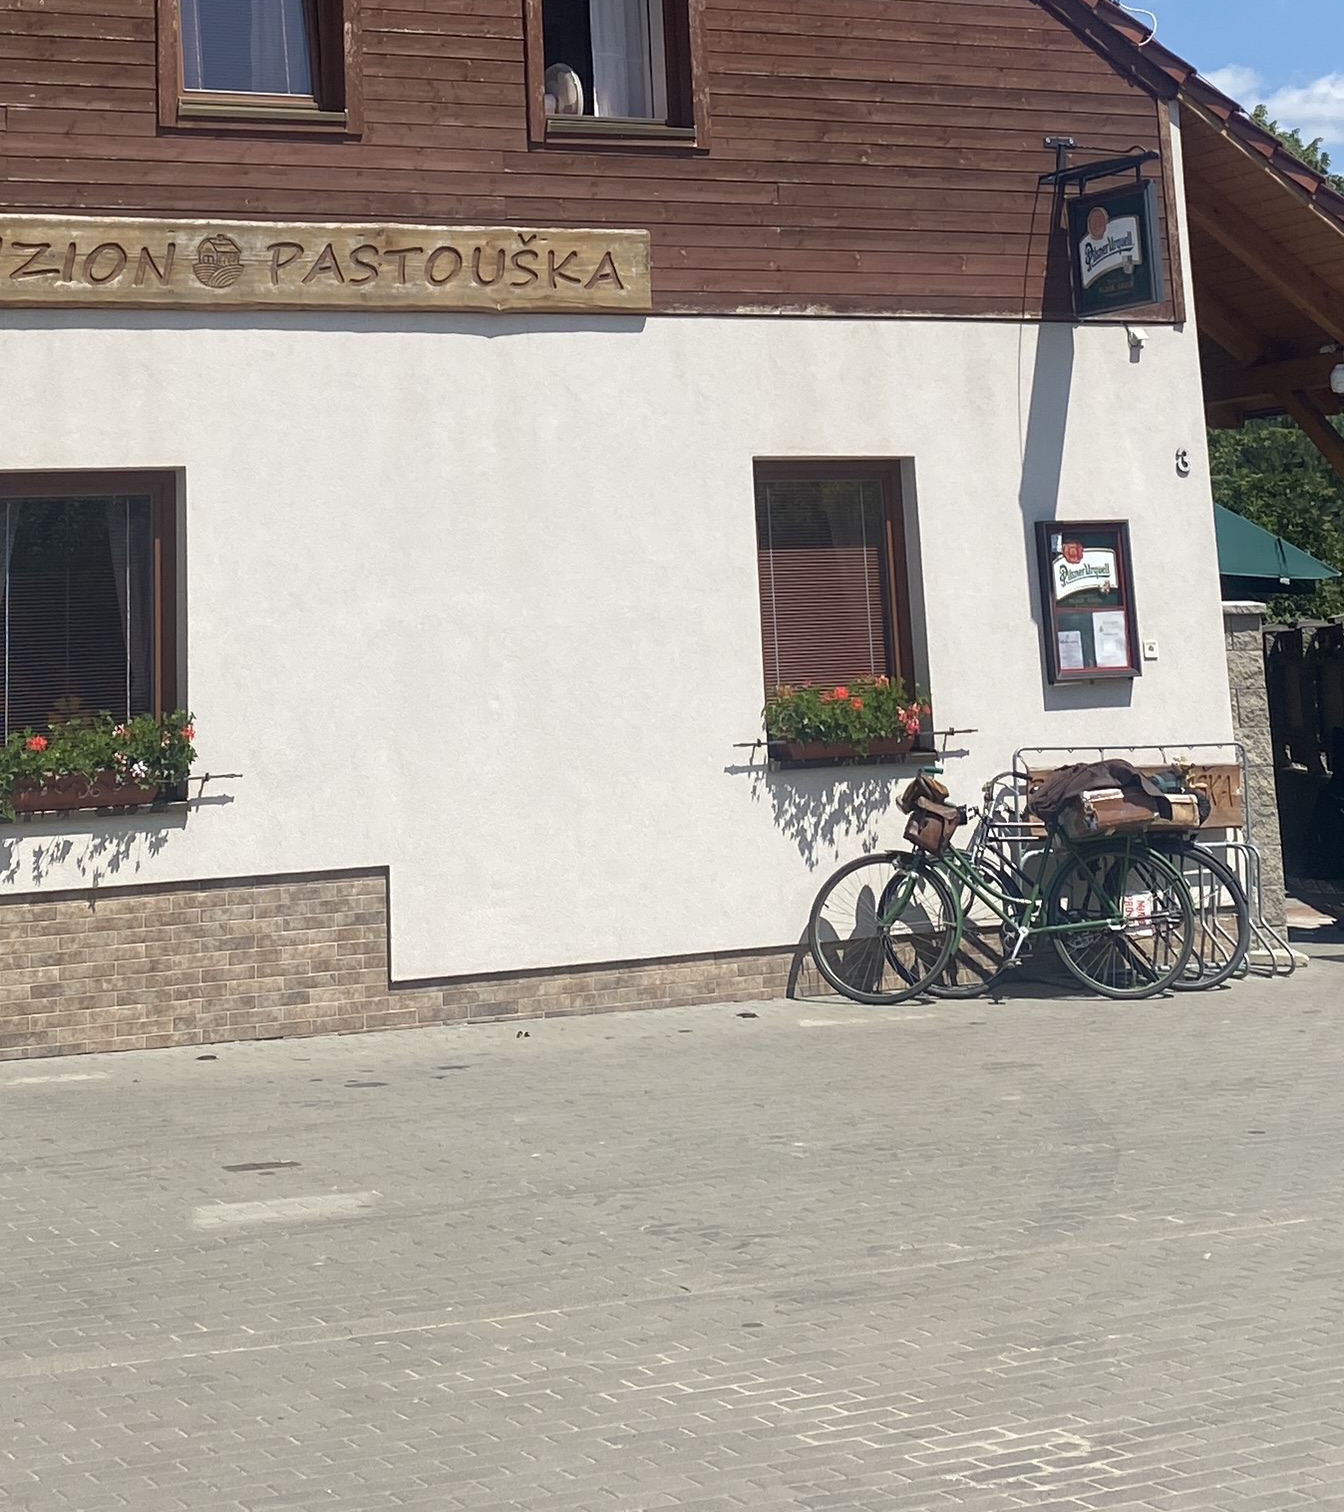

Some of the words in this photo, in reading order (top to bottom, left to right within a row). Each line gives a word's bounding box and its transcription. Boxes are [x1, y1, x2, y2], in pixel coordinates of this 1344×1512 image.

[267, 233, 624, 289] PASTOUŠKA
[1085, 242, 1109, 272] Pilsner
[1107, 231, 1133, 255] Urquell
[1059, 564, 1085, 587] Pilsner
[1084, 563, 1109, 579] Urquell
